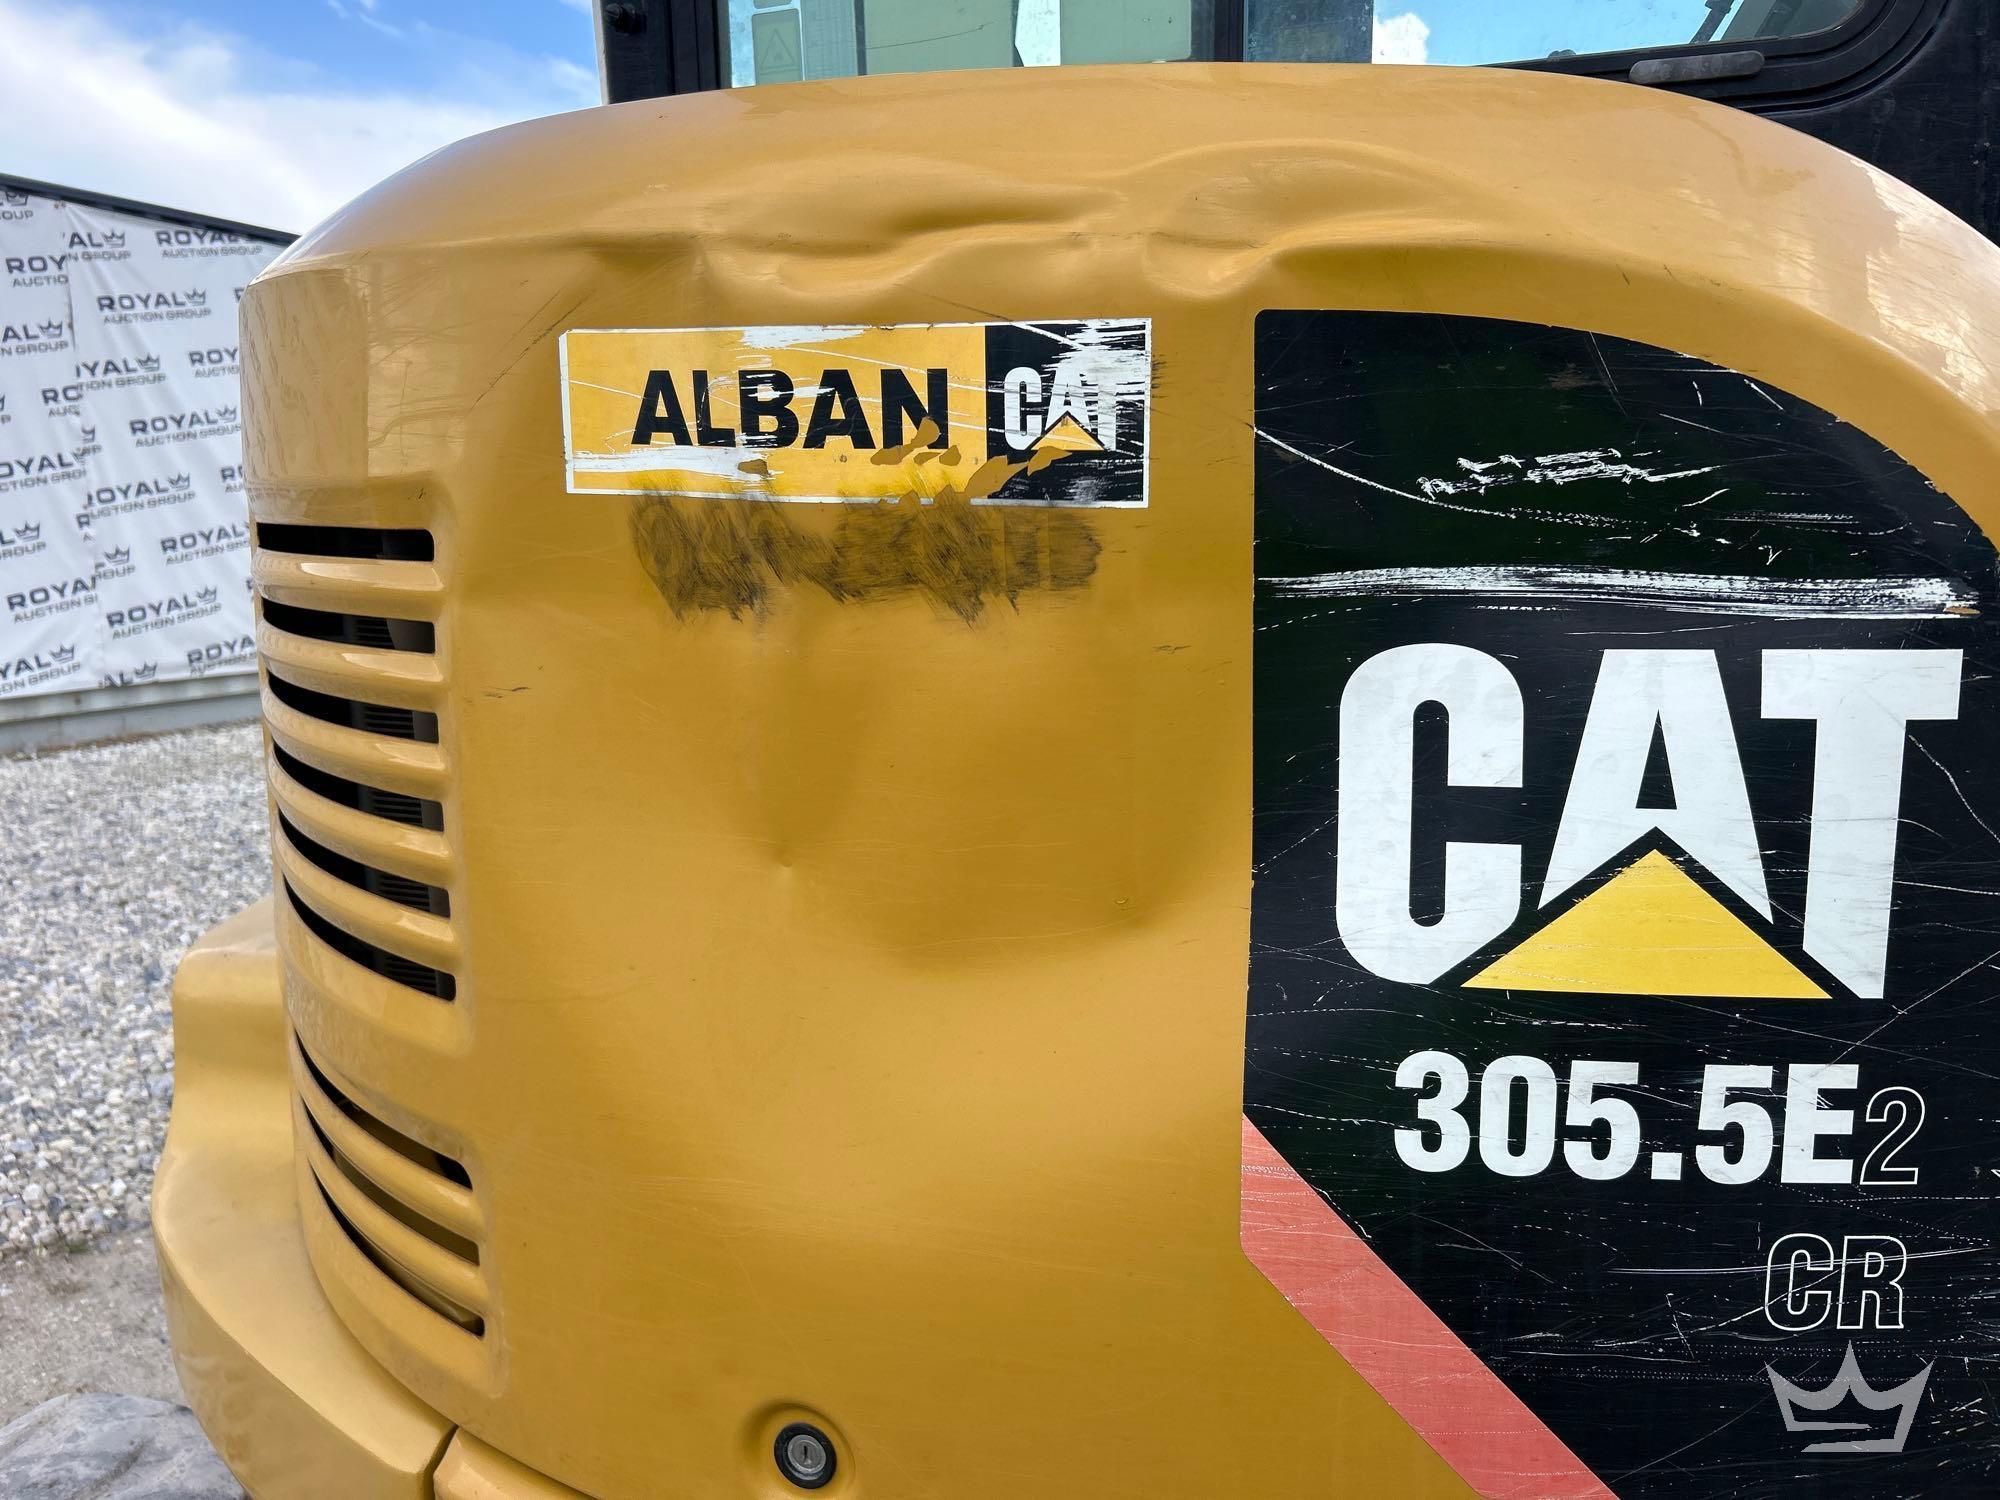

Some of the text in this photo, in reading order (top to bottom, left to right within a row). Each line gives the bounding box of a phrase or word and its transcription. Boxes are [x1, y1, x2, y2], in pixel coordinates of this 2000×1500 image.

[0, 210, 34, 220] OUP
[162, 245, 263, 259] AUCTION GROUP
[96, 291, 186, 312] ROYAL
[103, 307, 212, 325] AUCTION GROUP
[15, 340, 69, 356] GROUP
[631, 365, 1122, 451] ALBAN CAT
[129, 409, 218, 435] ROYAL
[135, 430, 197, 448] AUCTION
[147, 490, 196, 509] GROUP
[161, 523, 244, 554] ROYAL
[14, 598, 81, 624] AUCTION
[106, 593, 197, 629] ROYAL
[112, 602, 222, 640] AUCTION GROUP
[28, 661, 81, 687] GROUP
[1336, 642, 1964, 1000] CAT
[1765, 1233, 1908, 1331] CR
